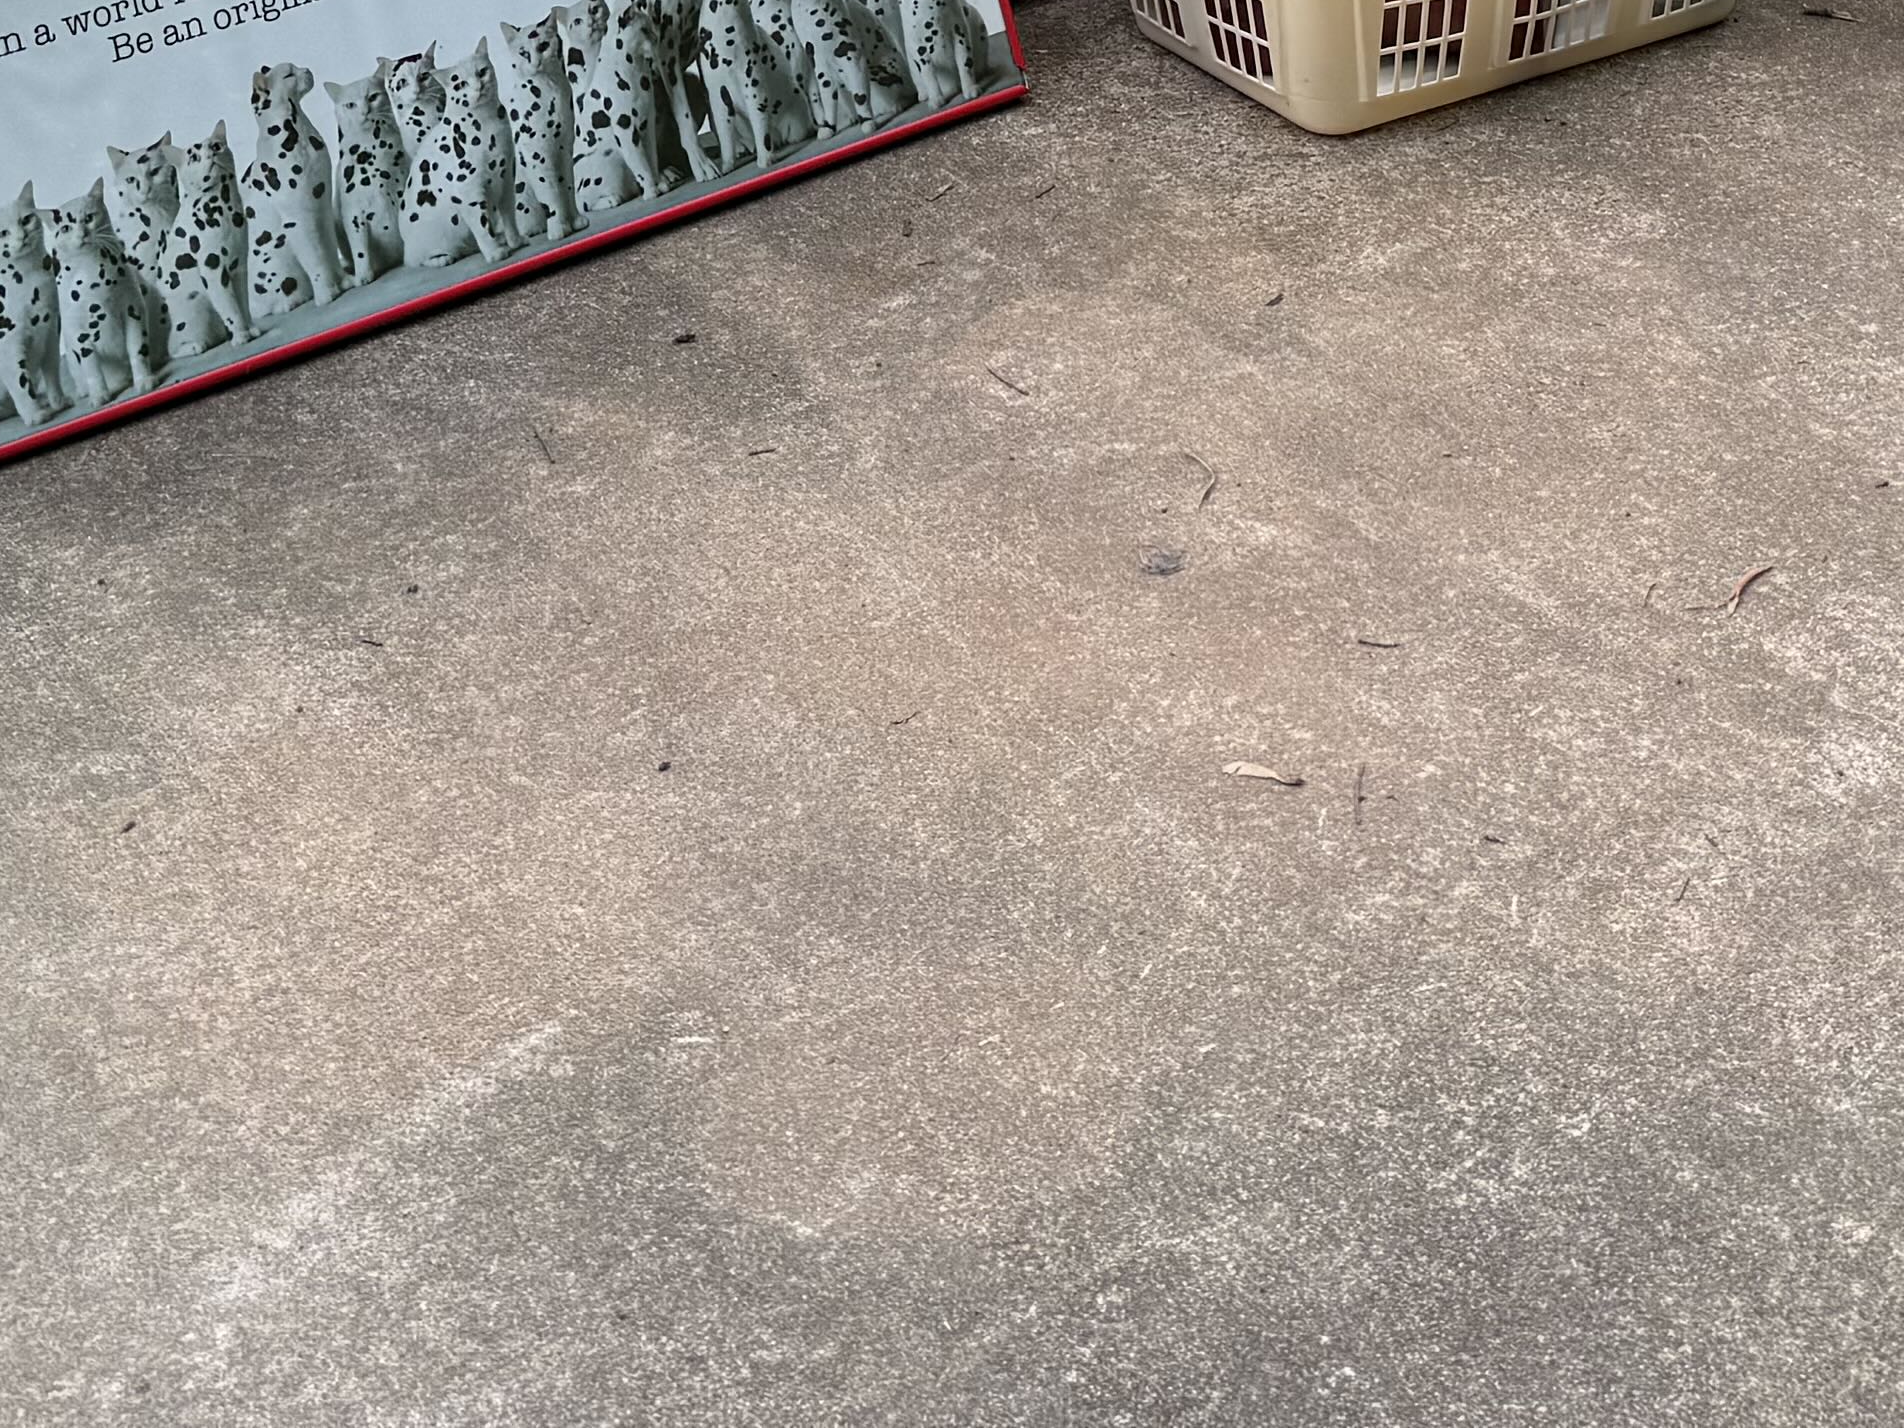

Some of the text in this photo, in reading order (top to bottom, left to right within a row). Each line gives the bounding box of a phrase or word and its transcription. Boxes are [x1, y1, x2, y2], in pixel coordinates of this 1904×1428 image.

[32, 23, 56, 47] a
[108, 31, 156, 63] Be
[162, 15, 208, 46] an
